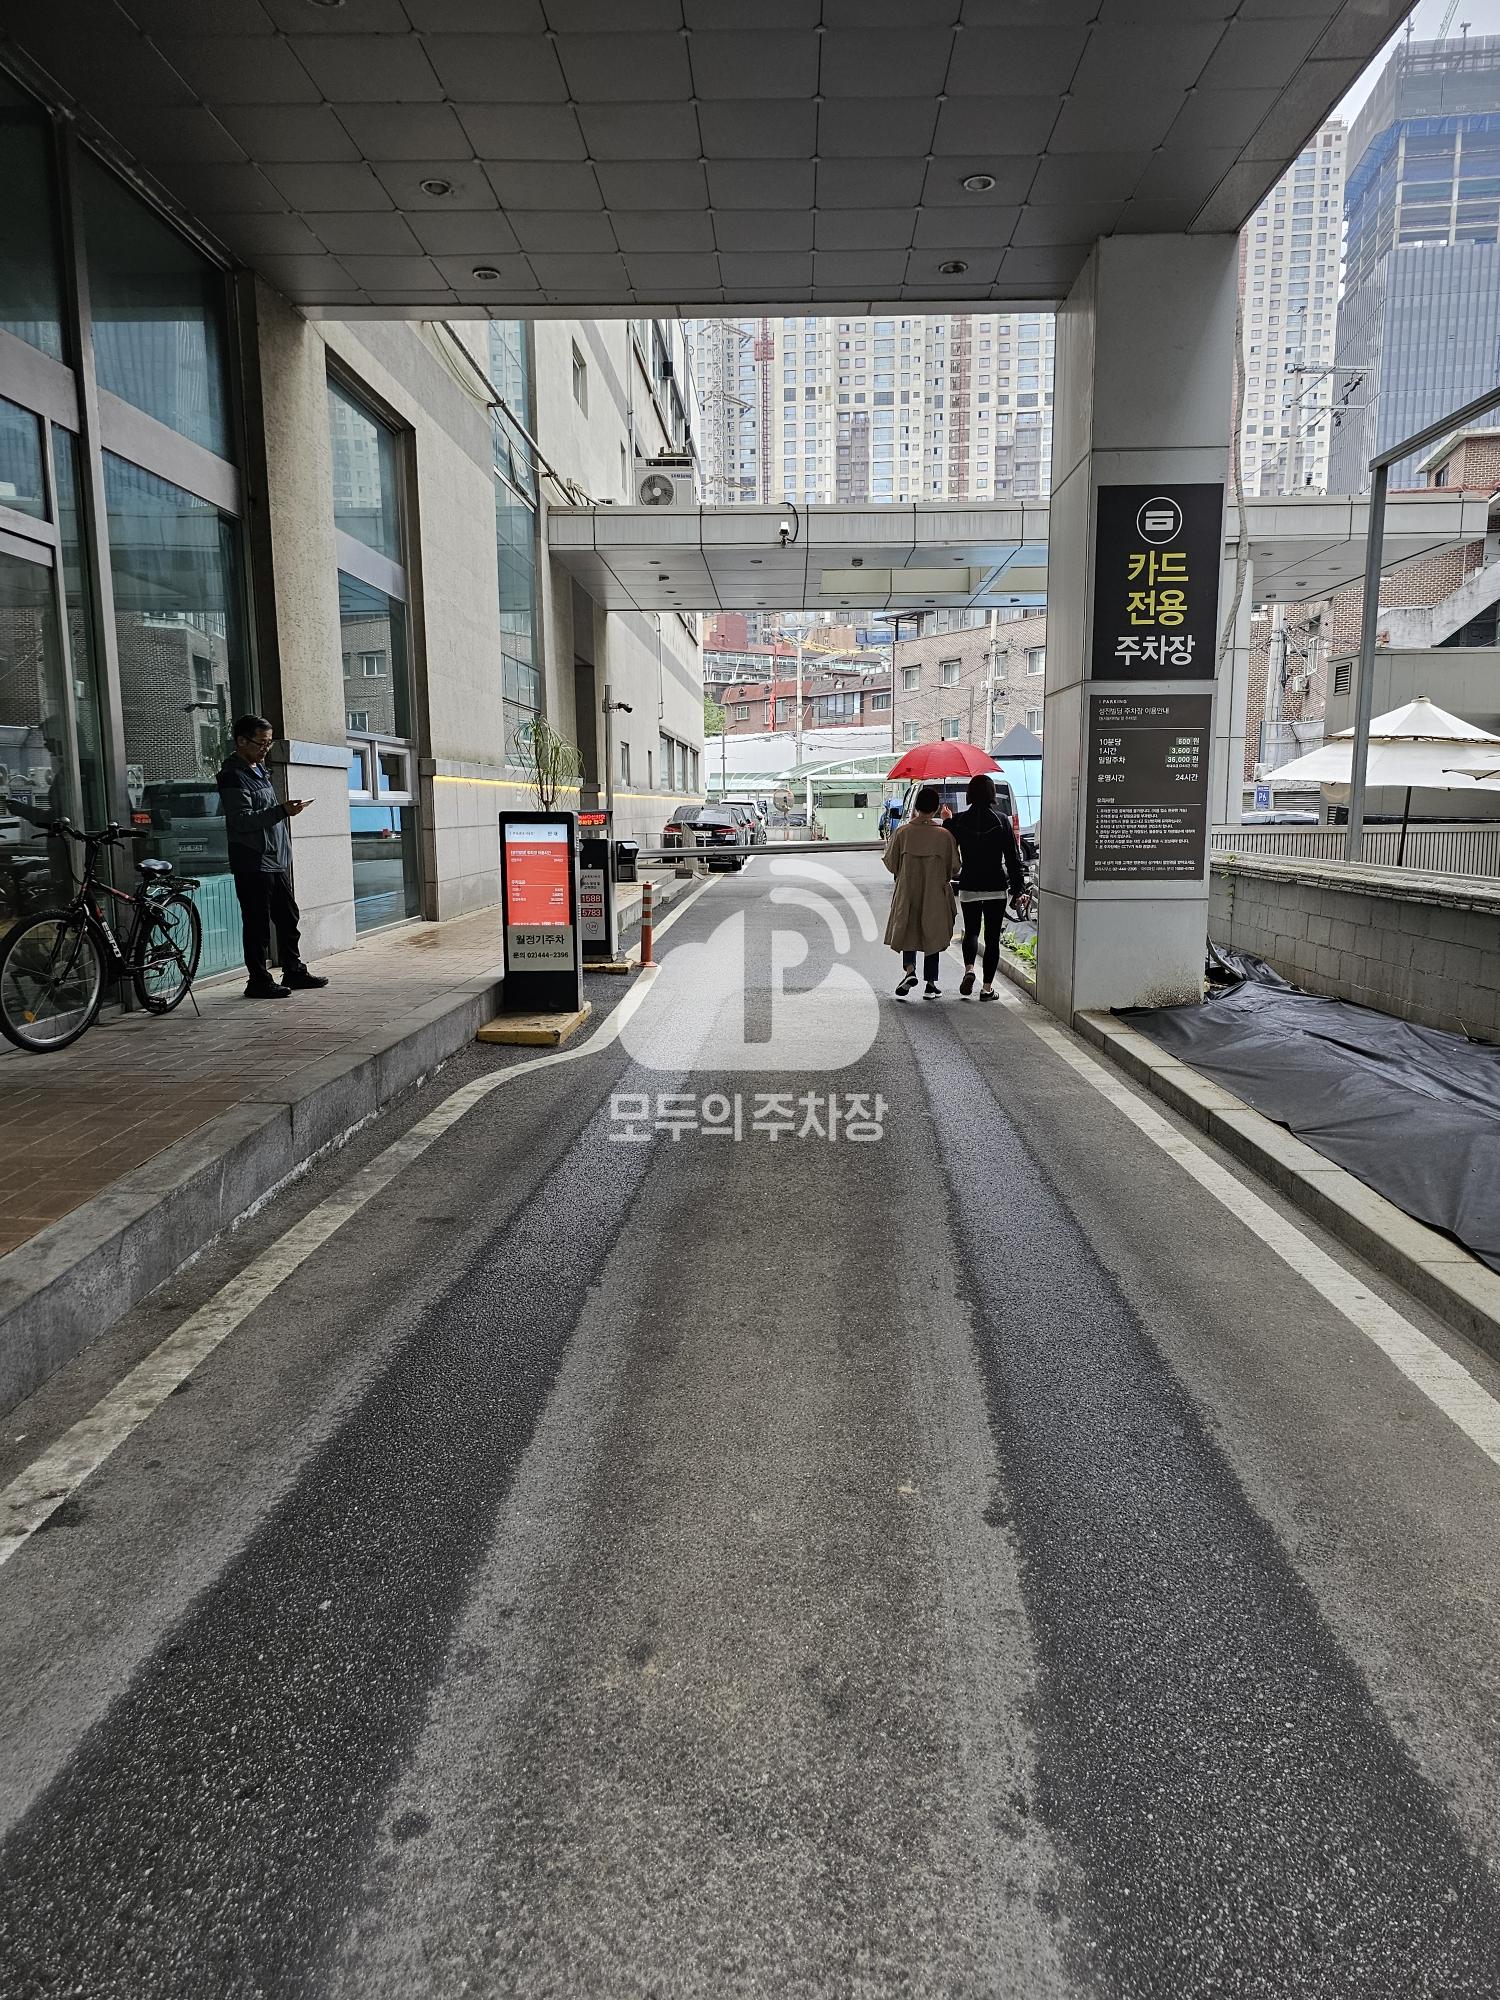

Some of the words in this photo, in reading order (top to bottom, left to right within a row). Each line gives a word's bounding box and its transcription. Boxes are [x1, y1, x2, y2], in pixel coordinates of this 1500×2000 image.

[1127, 550, 1189, 587] 카드
[1126, 589, 1188, 626] 전용
[1114, 634, 1196, 666] 주차장
[1099, 747, 1117, 755] 1시간
[1175, 773, 1198, 782] 24시간
[516, 934, 565, 945] 월정기주차
